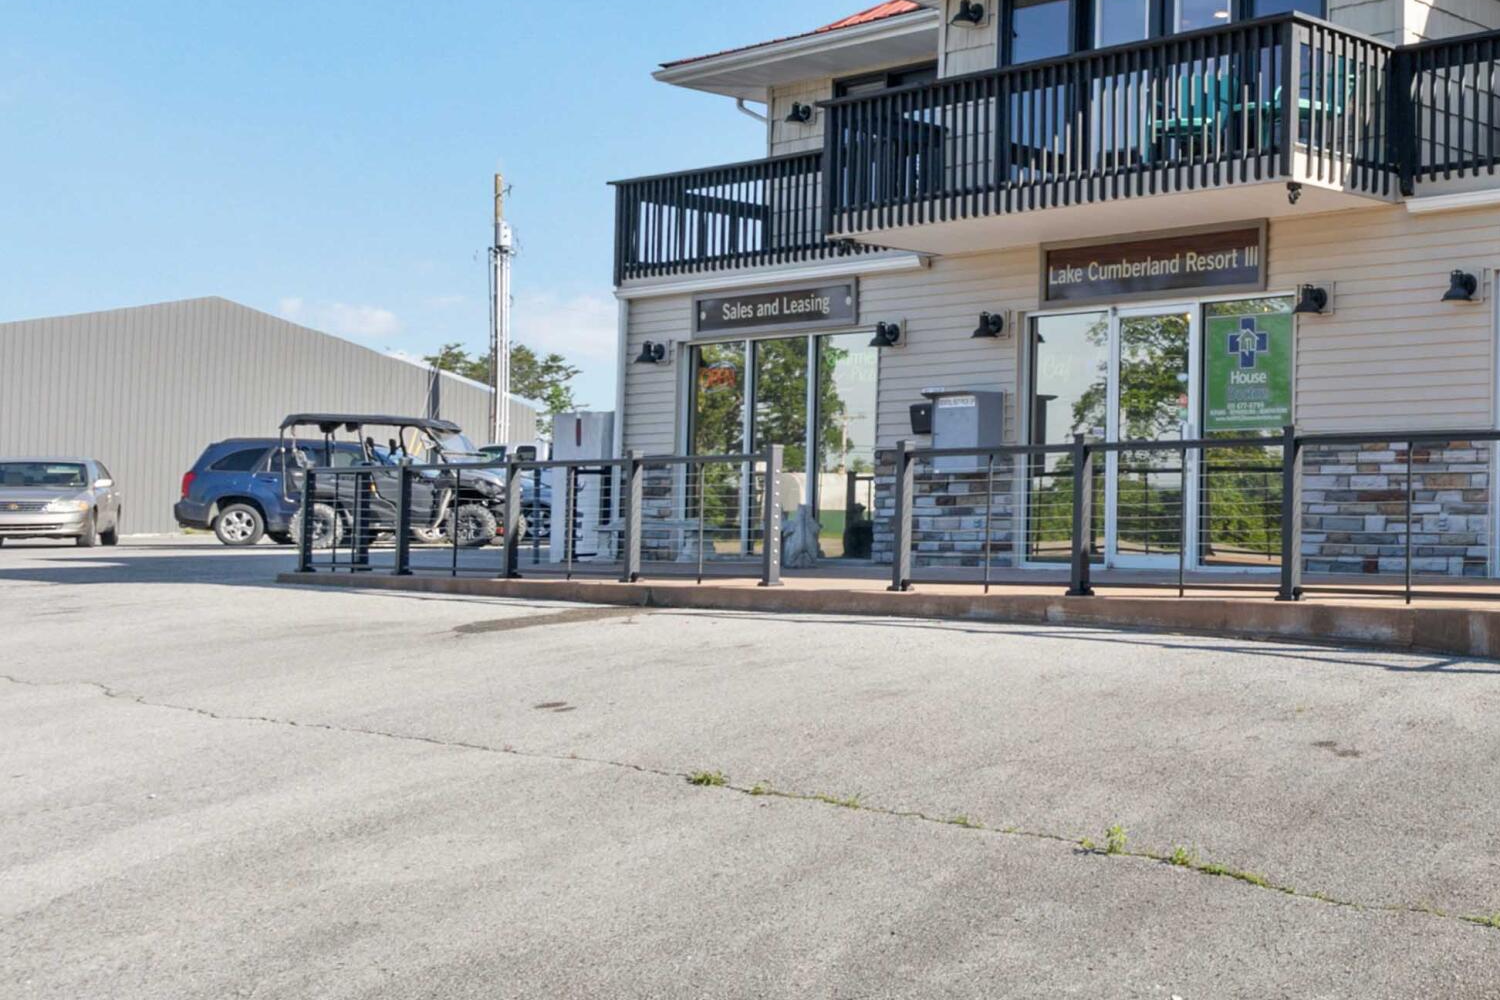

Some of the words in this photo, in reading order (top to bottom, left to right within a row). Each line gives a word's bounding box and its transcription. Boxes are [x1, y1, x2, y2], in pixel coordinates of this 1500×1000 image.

[1050, 264, 1083, 285] Lake
[1088, 254, 1180, 281] Cumberland
[1186, 248, 1238, 273] Resort
[722, 303, 754, 320] Sales
[756, 298, 779, 317] and
[783, 293, 831, 314] Leasing
[1230, 370, 1267, 385] House
